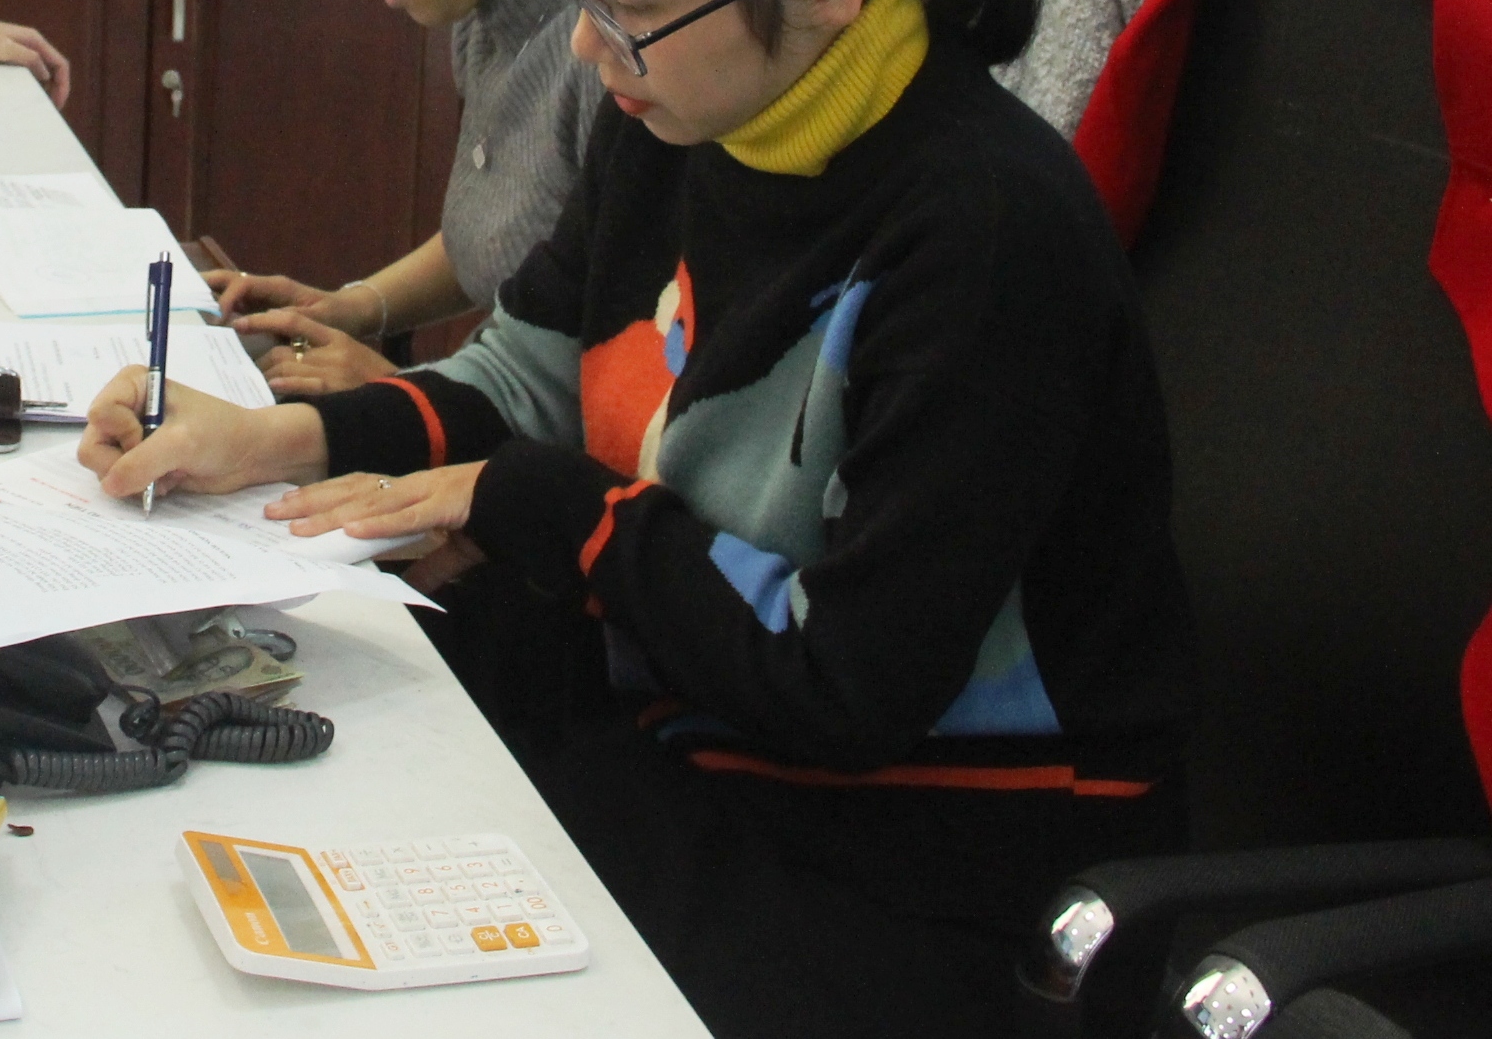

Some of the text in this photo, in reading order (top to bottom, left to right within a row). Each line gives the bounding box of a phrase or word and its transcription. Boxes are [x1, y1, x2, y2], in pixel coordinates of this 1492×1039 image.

[526, 896, 547, 910] 00
[244, 911, 270, 946] Canon
[515, 926, 530, 939] CA
[546, 924, 563, 932] 0
